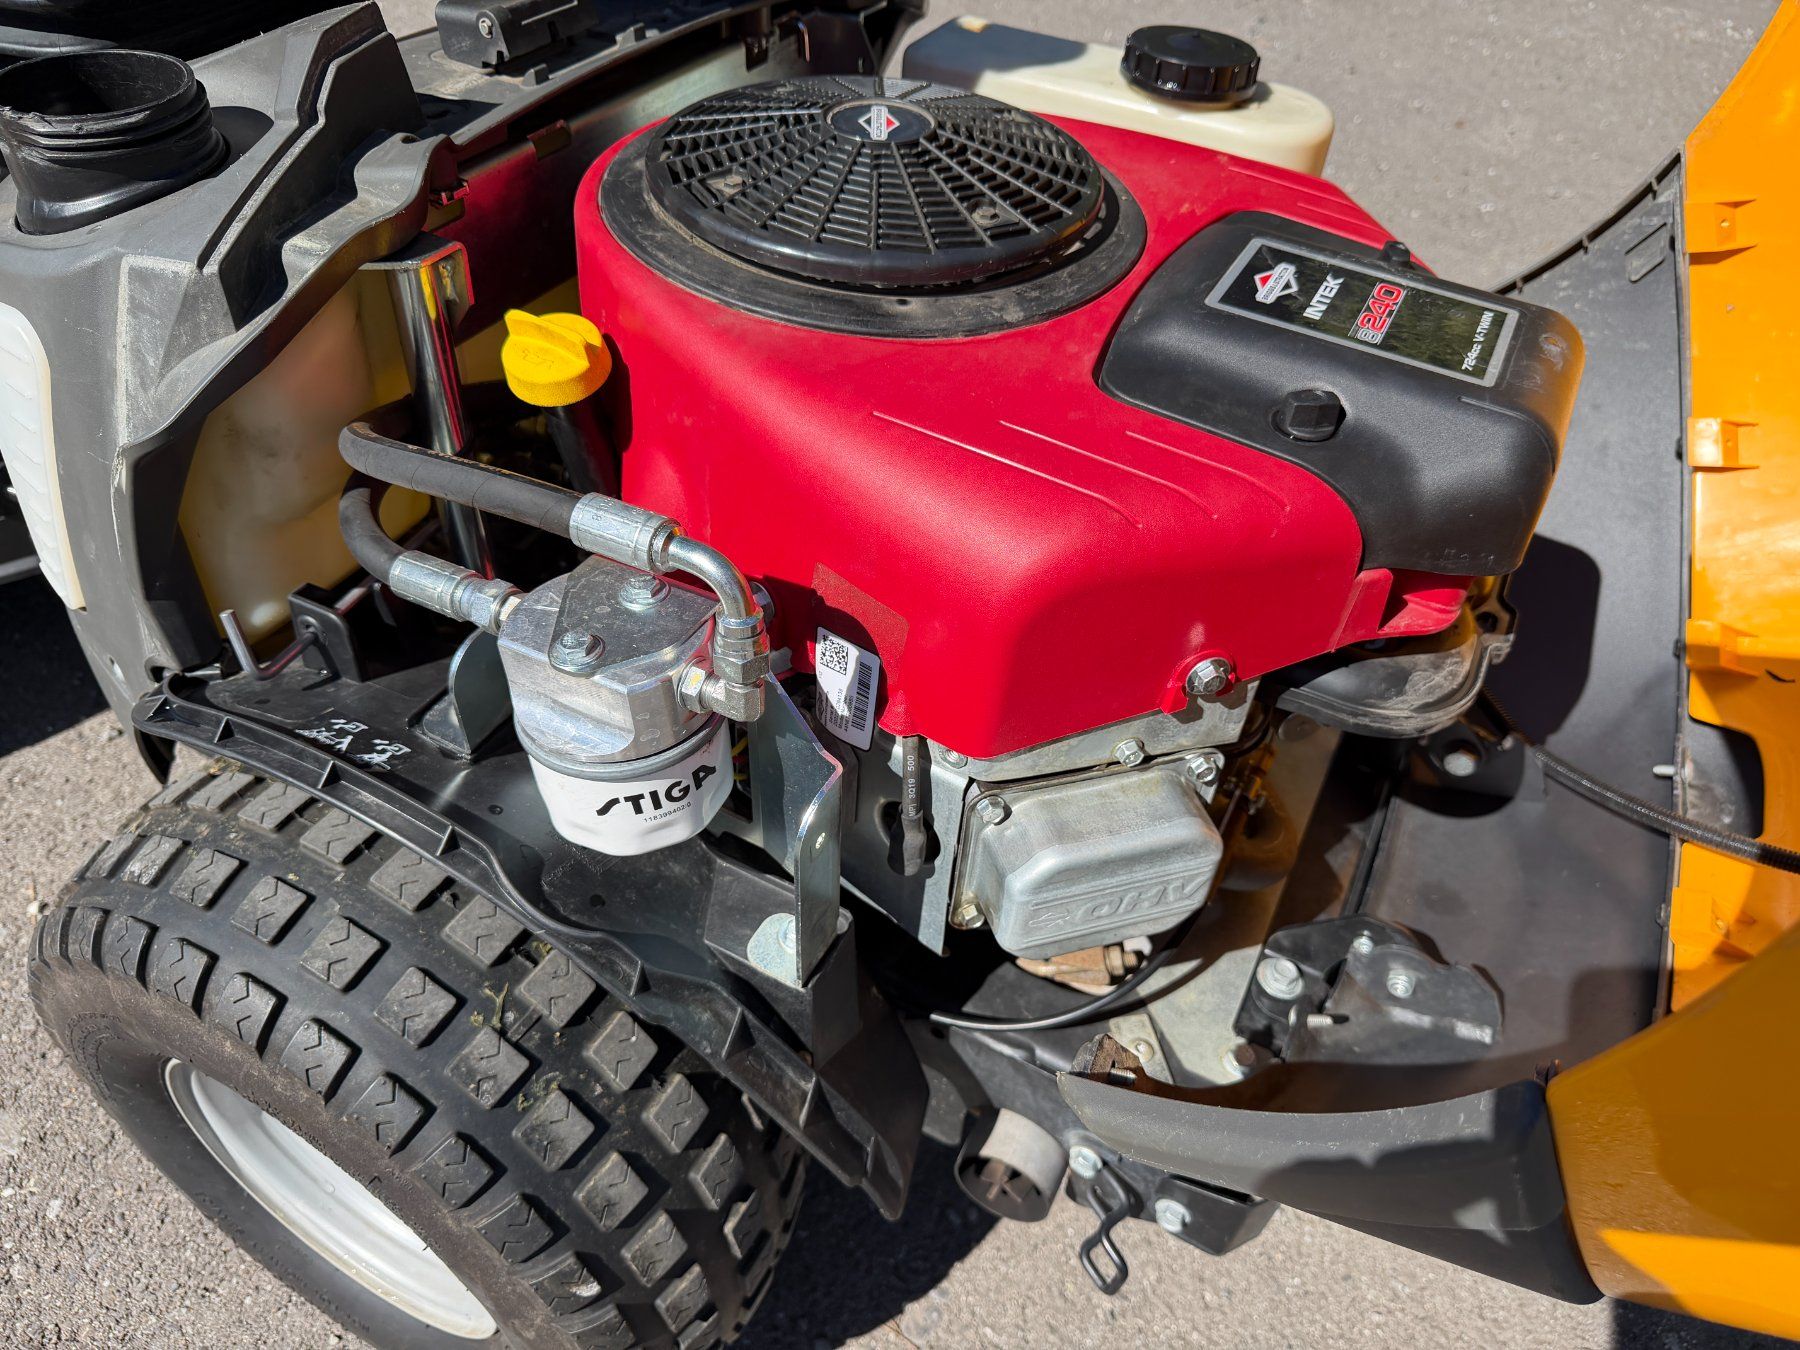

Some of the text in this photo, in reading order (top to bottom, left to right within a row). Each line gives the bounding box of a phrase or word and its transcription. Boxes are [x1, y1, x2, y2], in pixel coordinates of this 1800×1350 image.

[1302, 272, 1345, 320] INTEK
[1461, 310, 1495, 371] 724cc V-TWIN
[906, 755, 915, 772] 500
[596, 764, 717, 817] STIGA
